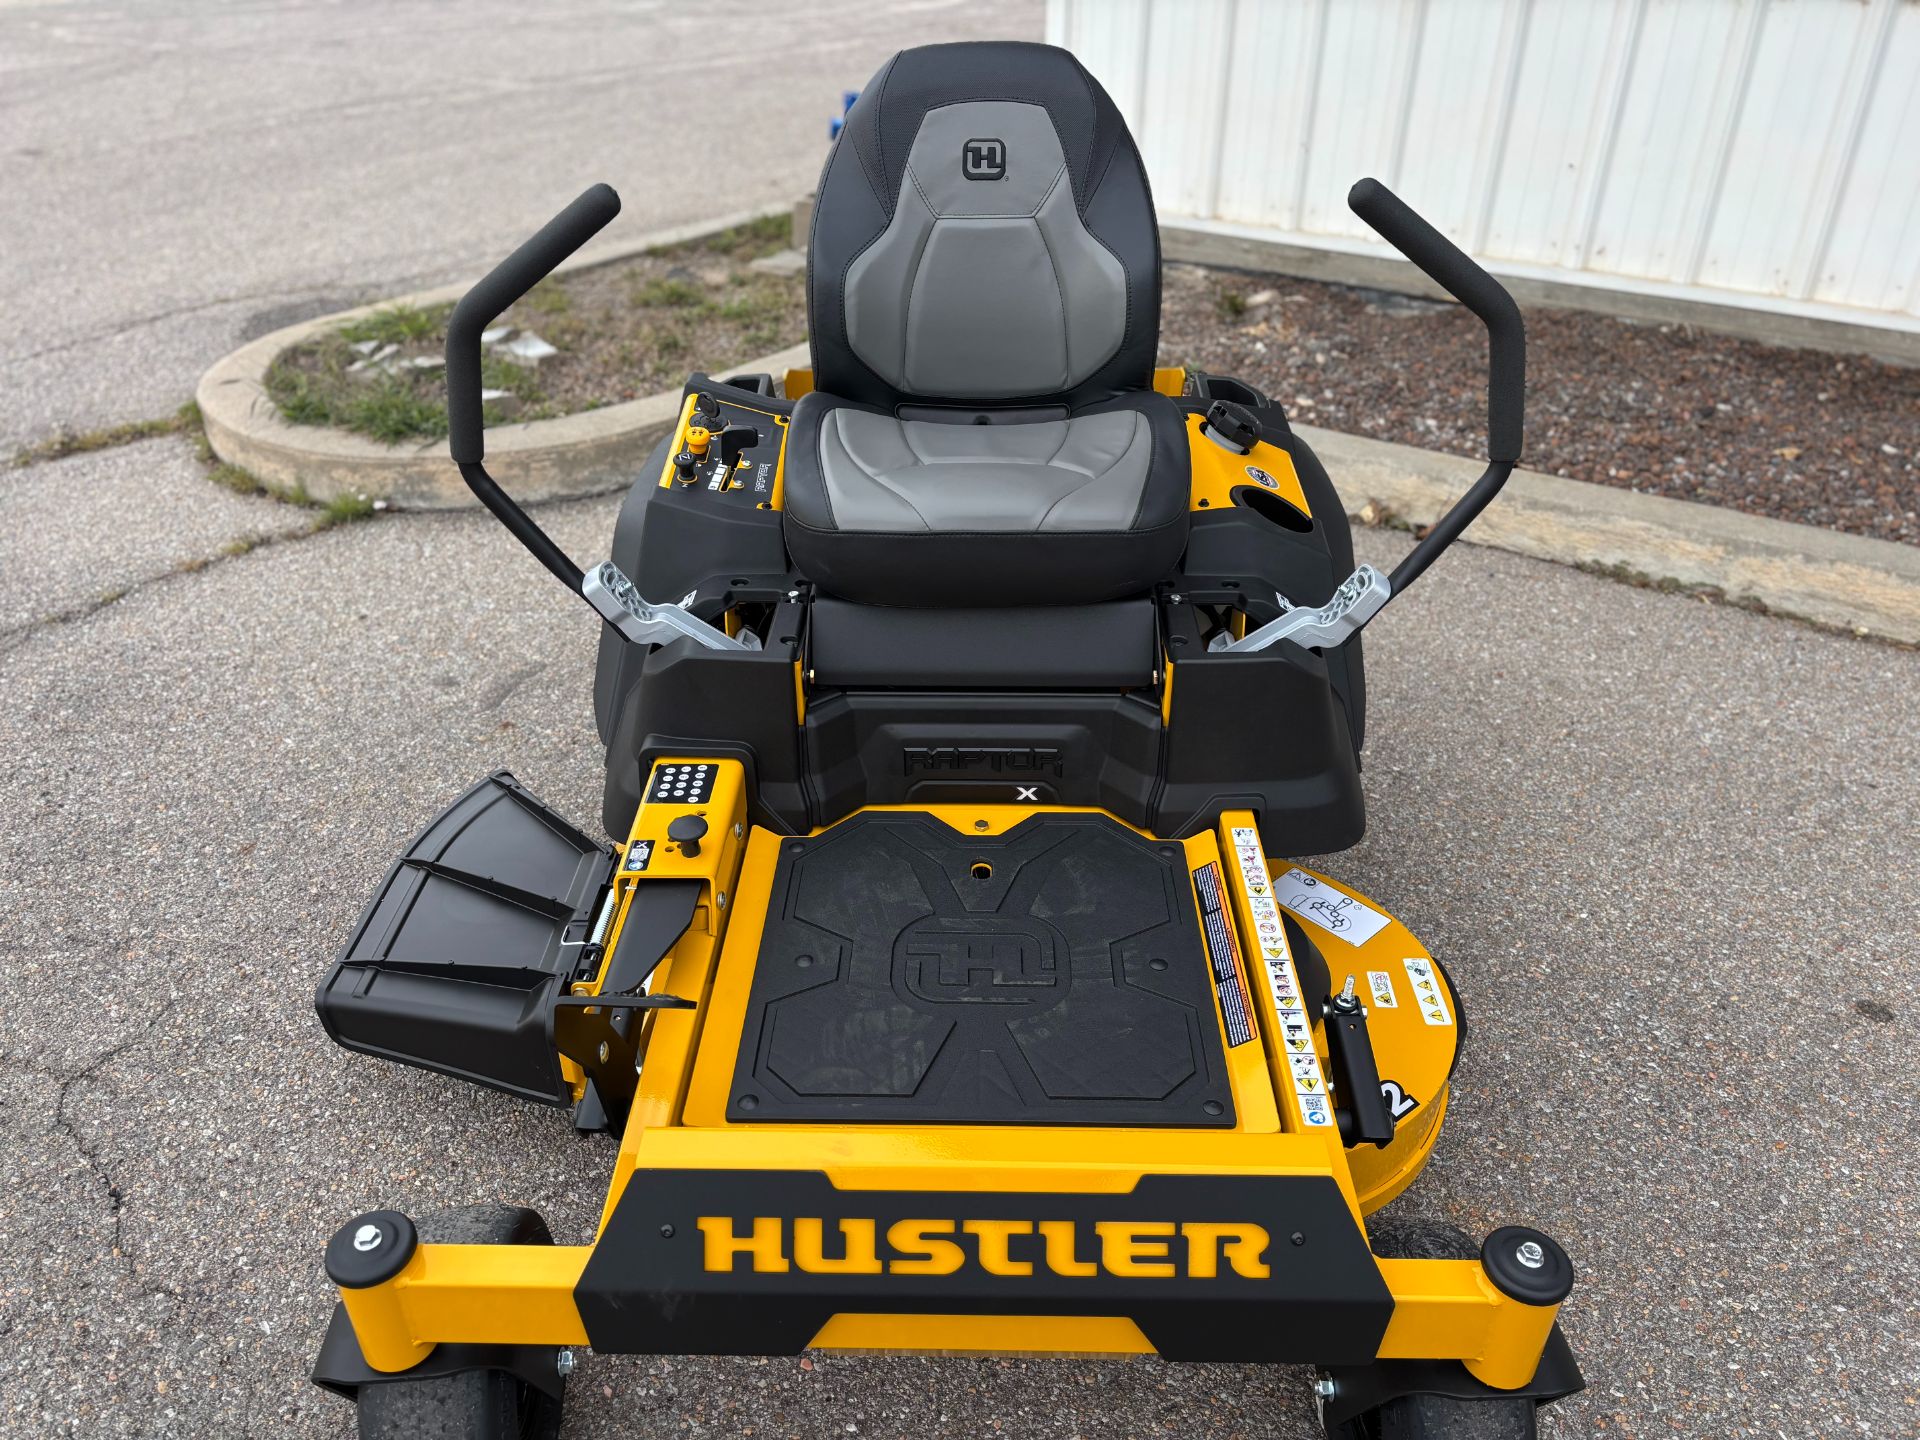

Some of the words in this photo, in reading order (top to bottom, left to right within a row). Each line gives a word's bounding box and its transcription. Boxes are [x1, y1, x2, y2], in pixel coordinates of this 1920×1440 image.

[903, 747, 1063, 778] RAPTOR
[1016, 786, 1038, 801] X
[697, 1216, 1271, 1279] HUSTLER
